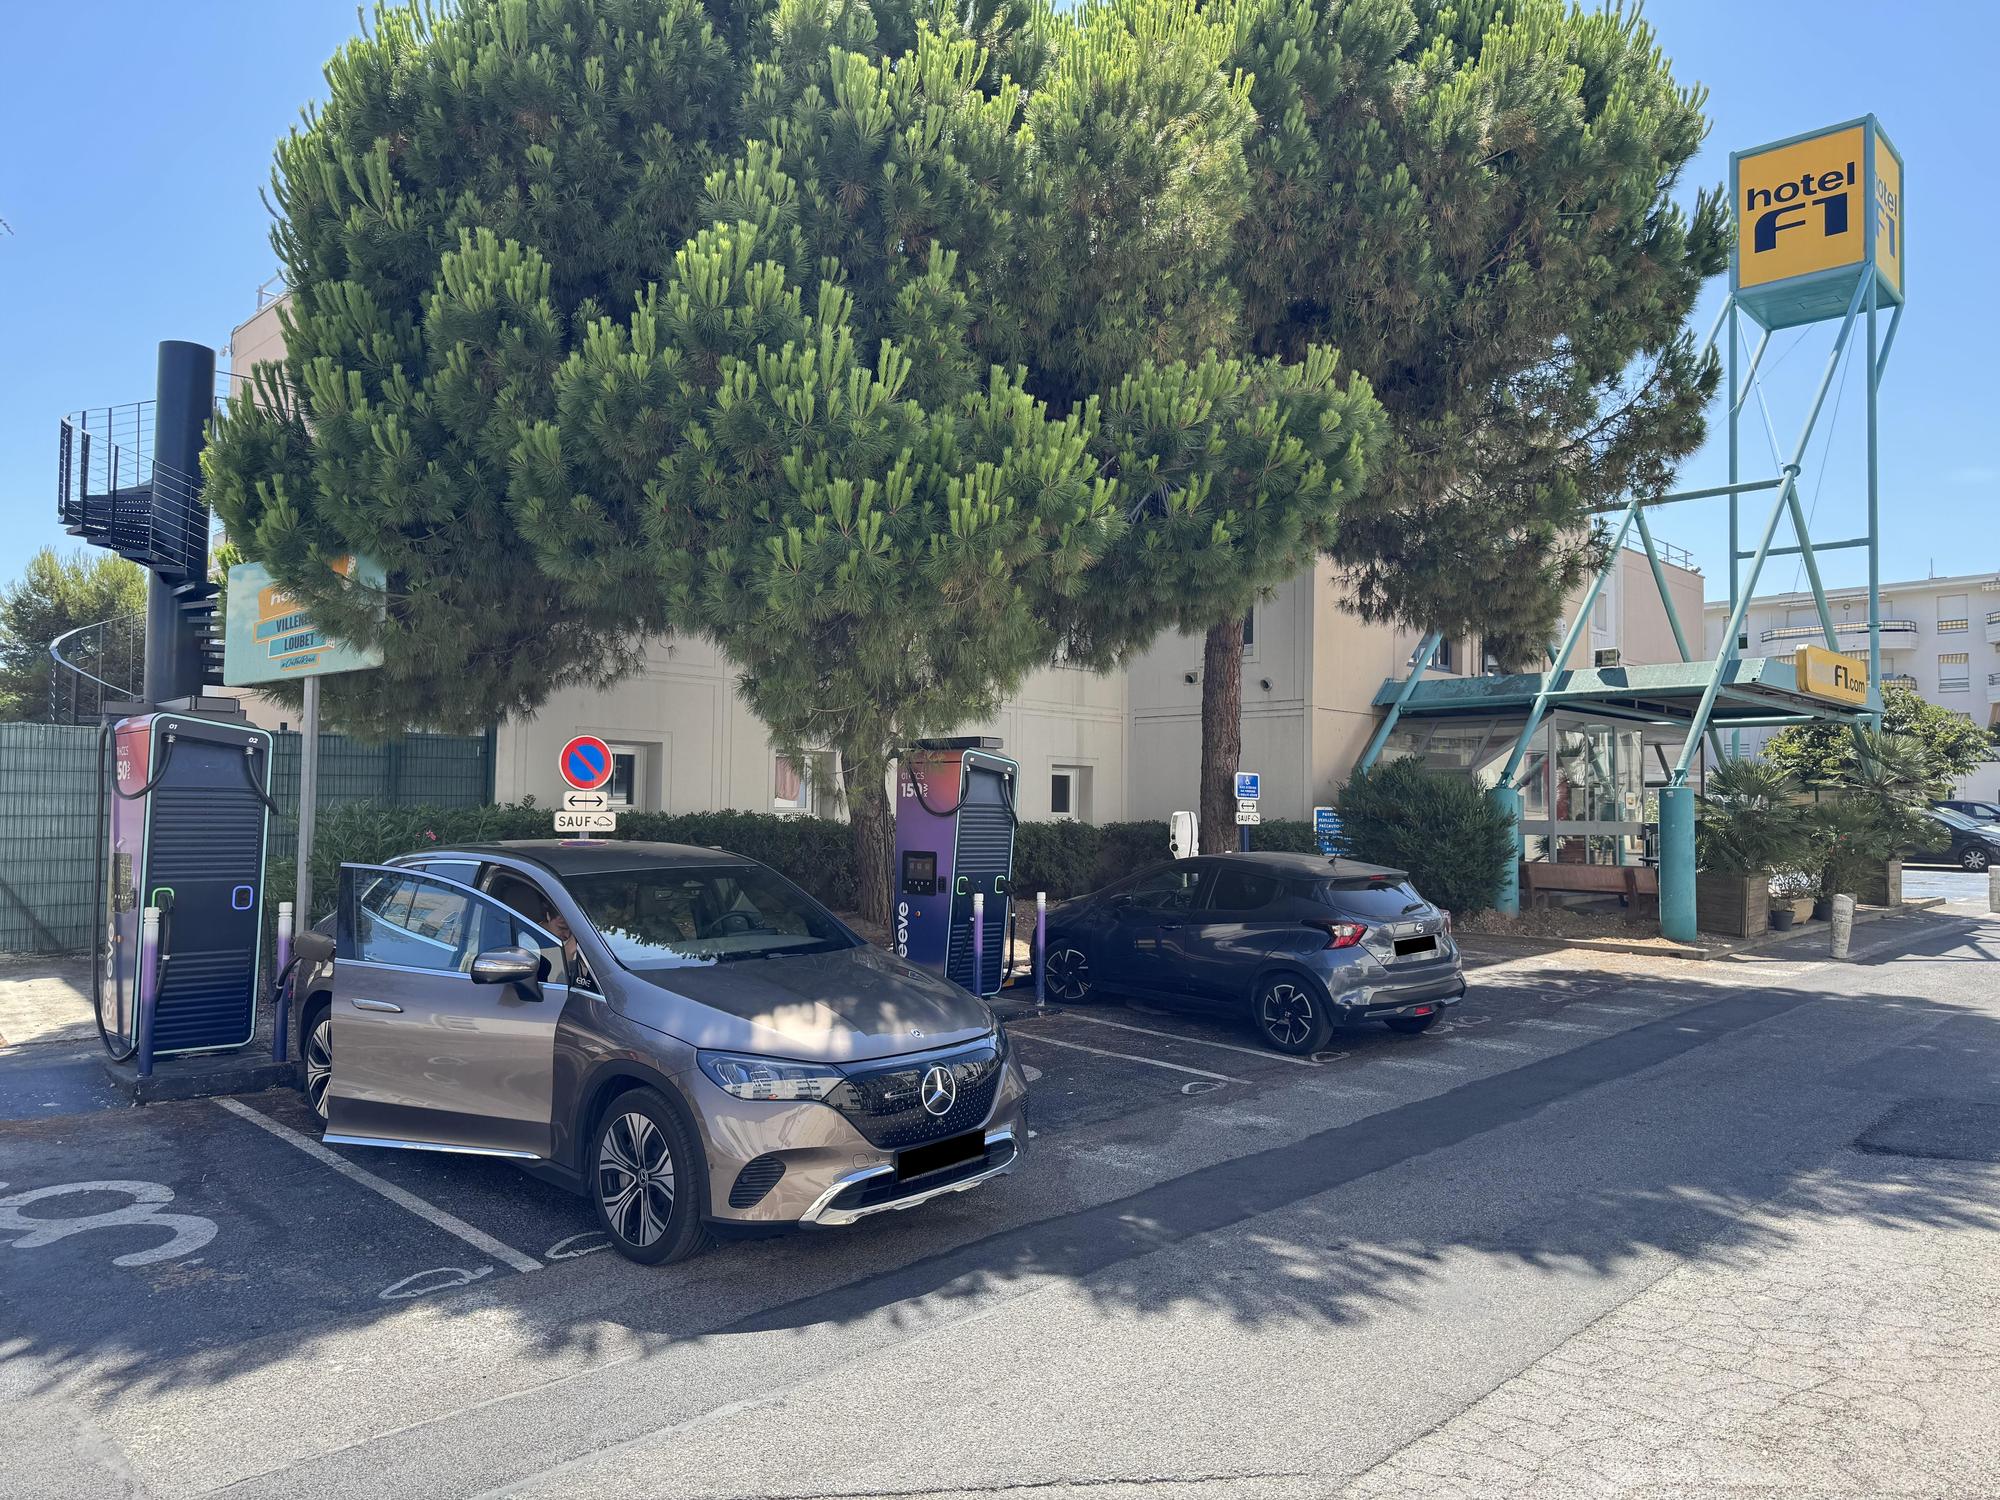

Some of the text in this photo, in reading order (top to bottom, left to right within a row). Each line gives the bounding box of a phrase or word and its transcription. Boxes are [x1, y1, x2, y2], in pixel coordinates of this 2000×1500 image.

[1747, 161, 1855, 211] hotel
[1875, 174, 1897, 217] otel
[1755, 192, 1848, 253] F1
[284, 632, 315, 651] LOUBET
[248, 736, 259, 744] 02
[558, 816, 592, 827] SAUF
[1237, 814, 1251, 822] SAUF
